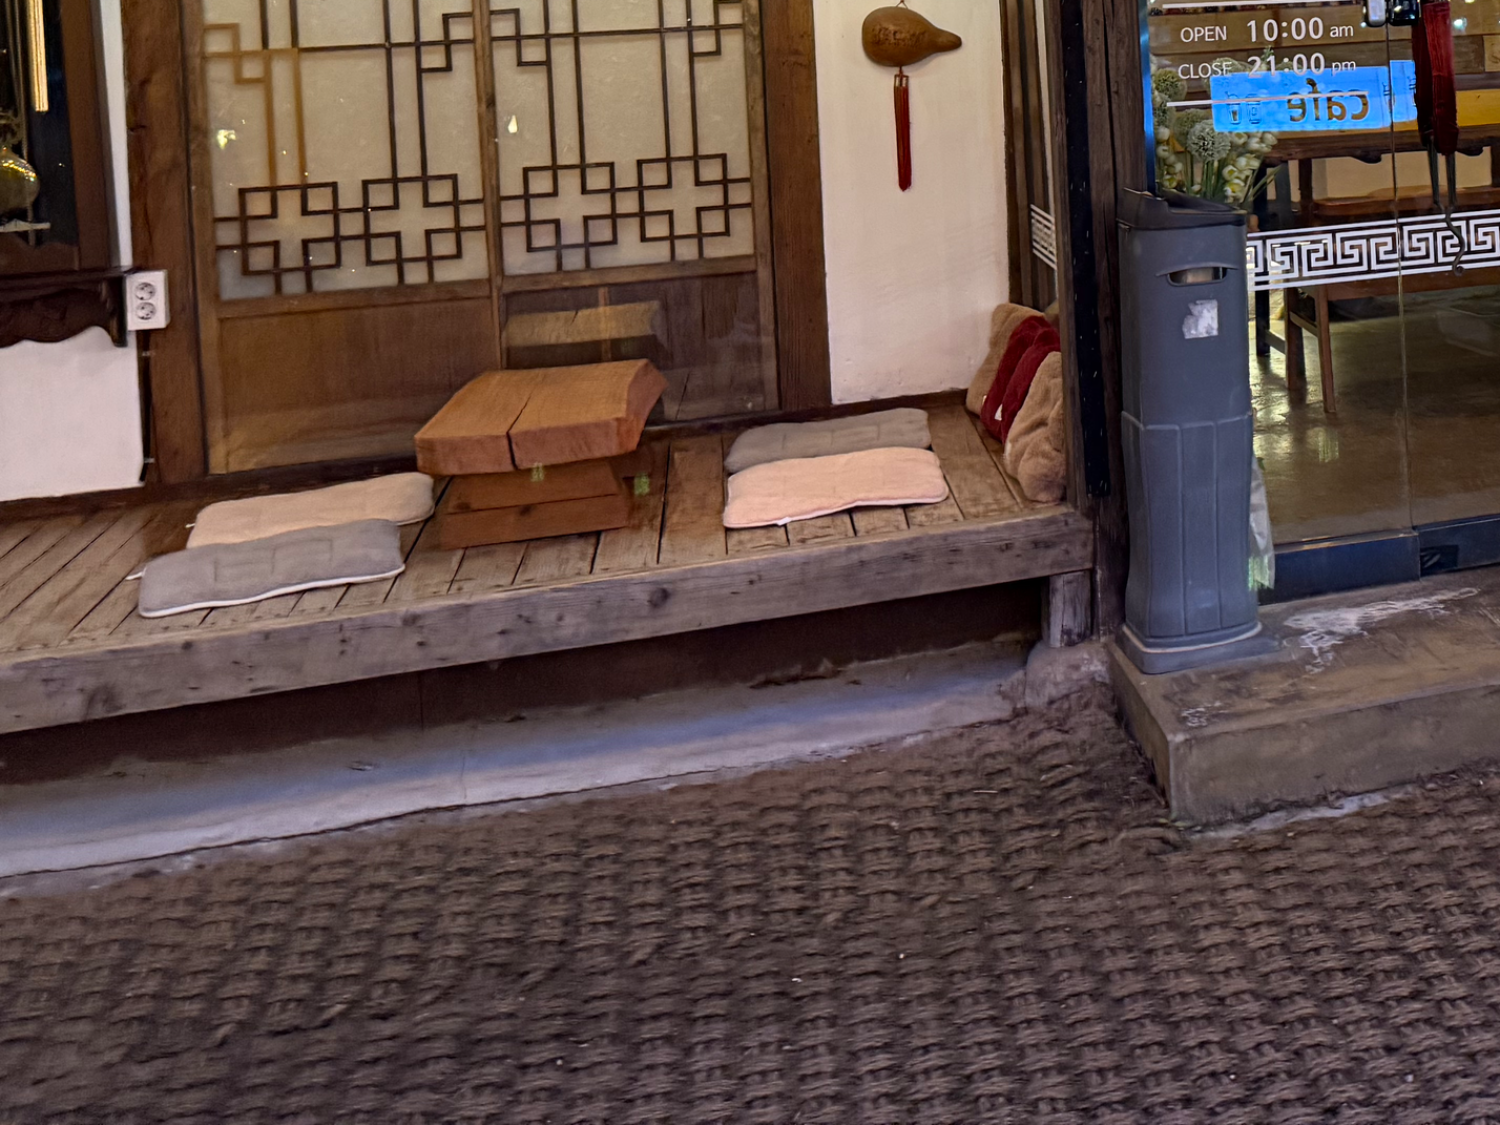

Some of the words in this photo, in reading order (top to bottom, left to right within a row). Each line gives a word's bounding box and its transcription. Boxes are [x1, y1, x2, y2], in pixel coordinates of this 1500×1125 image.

[1180, 26, 1227, 43] OPEN
[1247, 17, 1324, 43] 10:00
[1329, 25, 1354, 38] am
[1177, 61, 1233, 80] CLOSE
[1247, 52, 1326, 79] 21:00
[1331, 60, 1357, 77] pm
